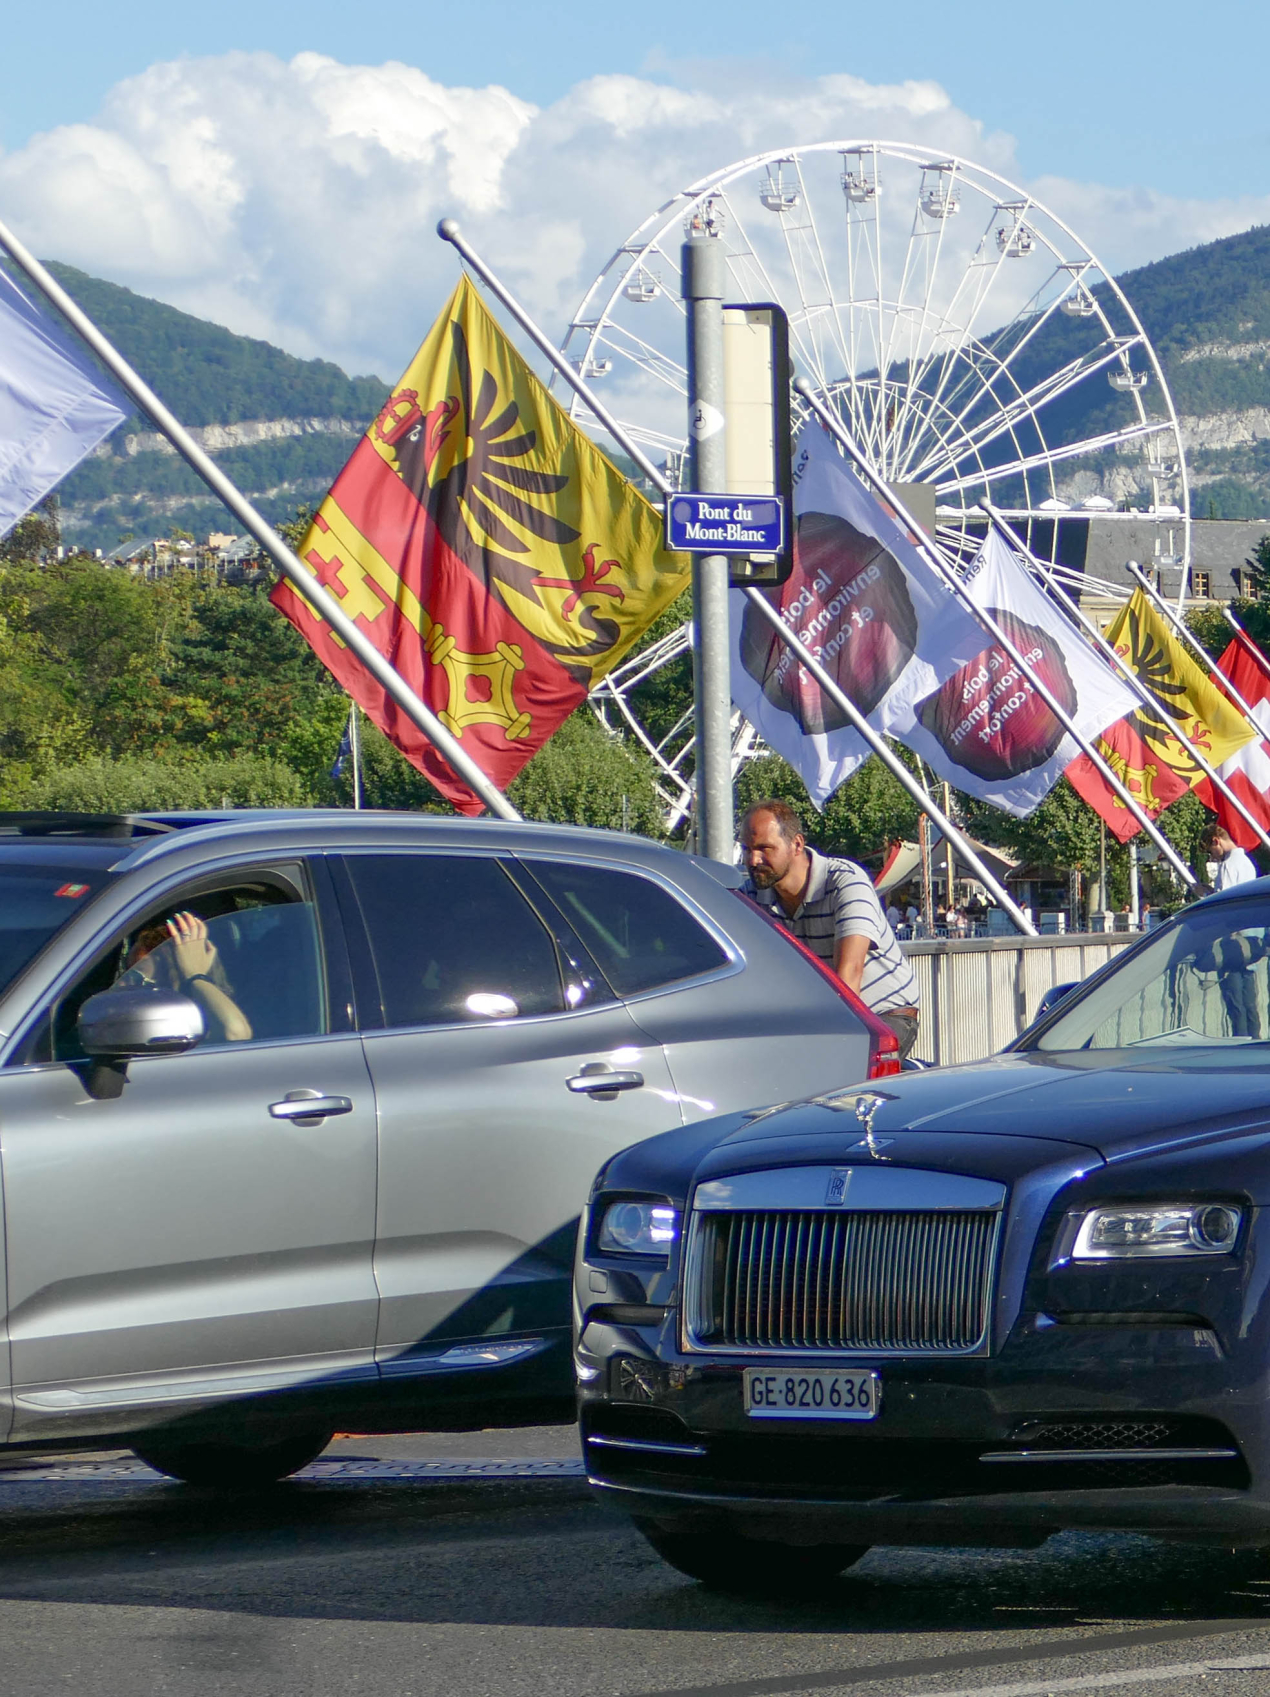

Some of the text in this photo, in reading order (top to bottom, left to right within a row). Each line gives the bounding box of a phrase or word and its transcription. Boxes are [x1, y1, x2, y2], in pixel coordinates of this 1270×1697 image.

[698, 502, 753, 521] Pont du
[684, 521, 766, 542] Mont-Blanc
